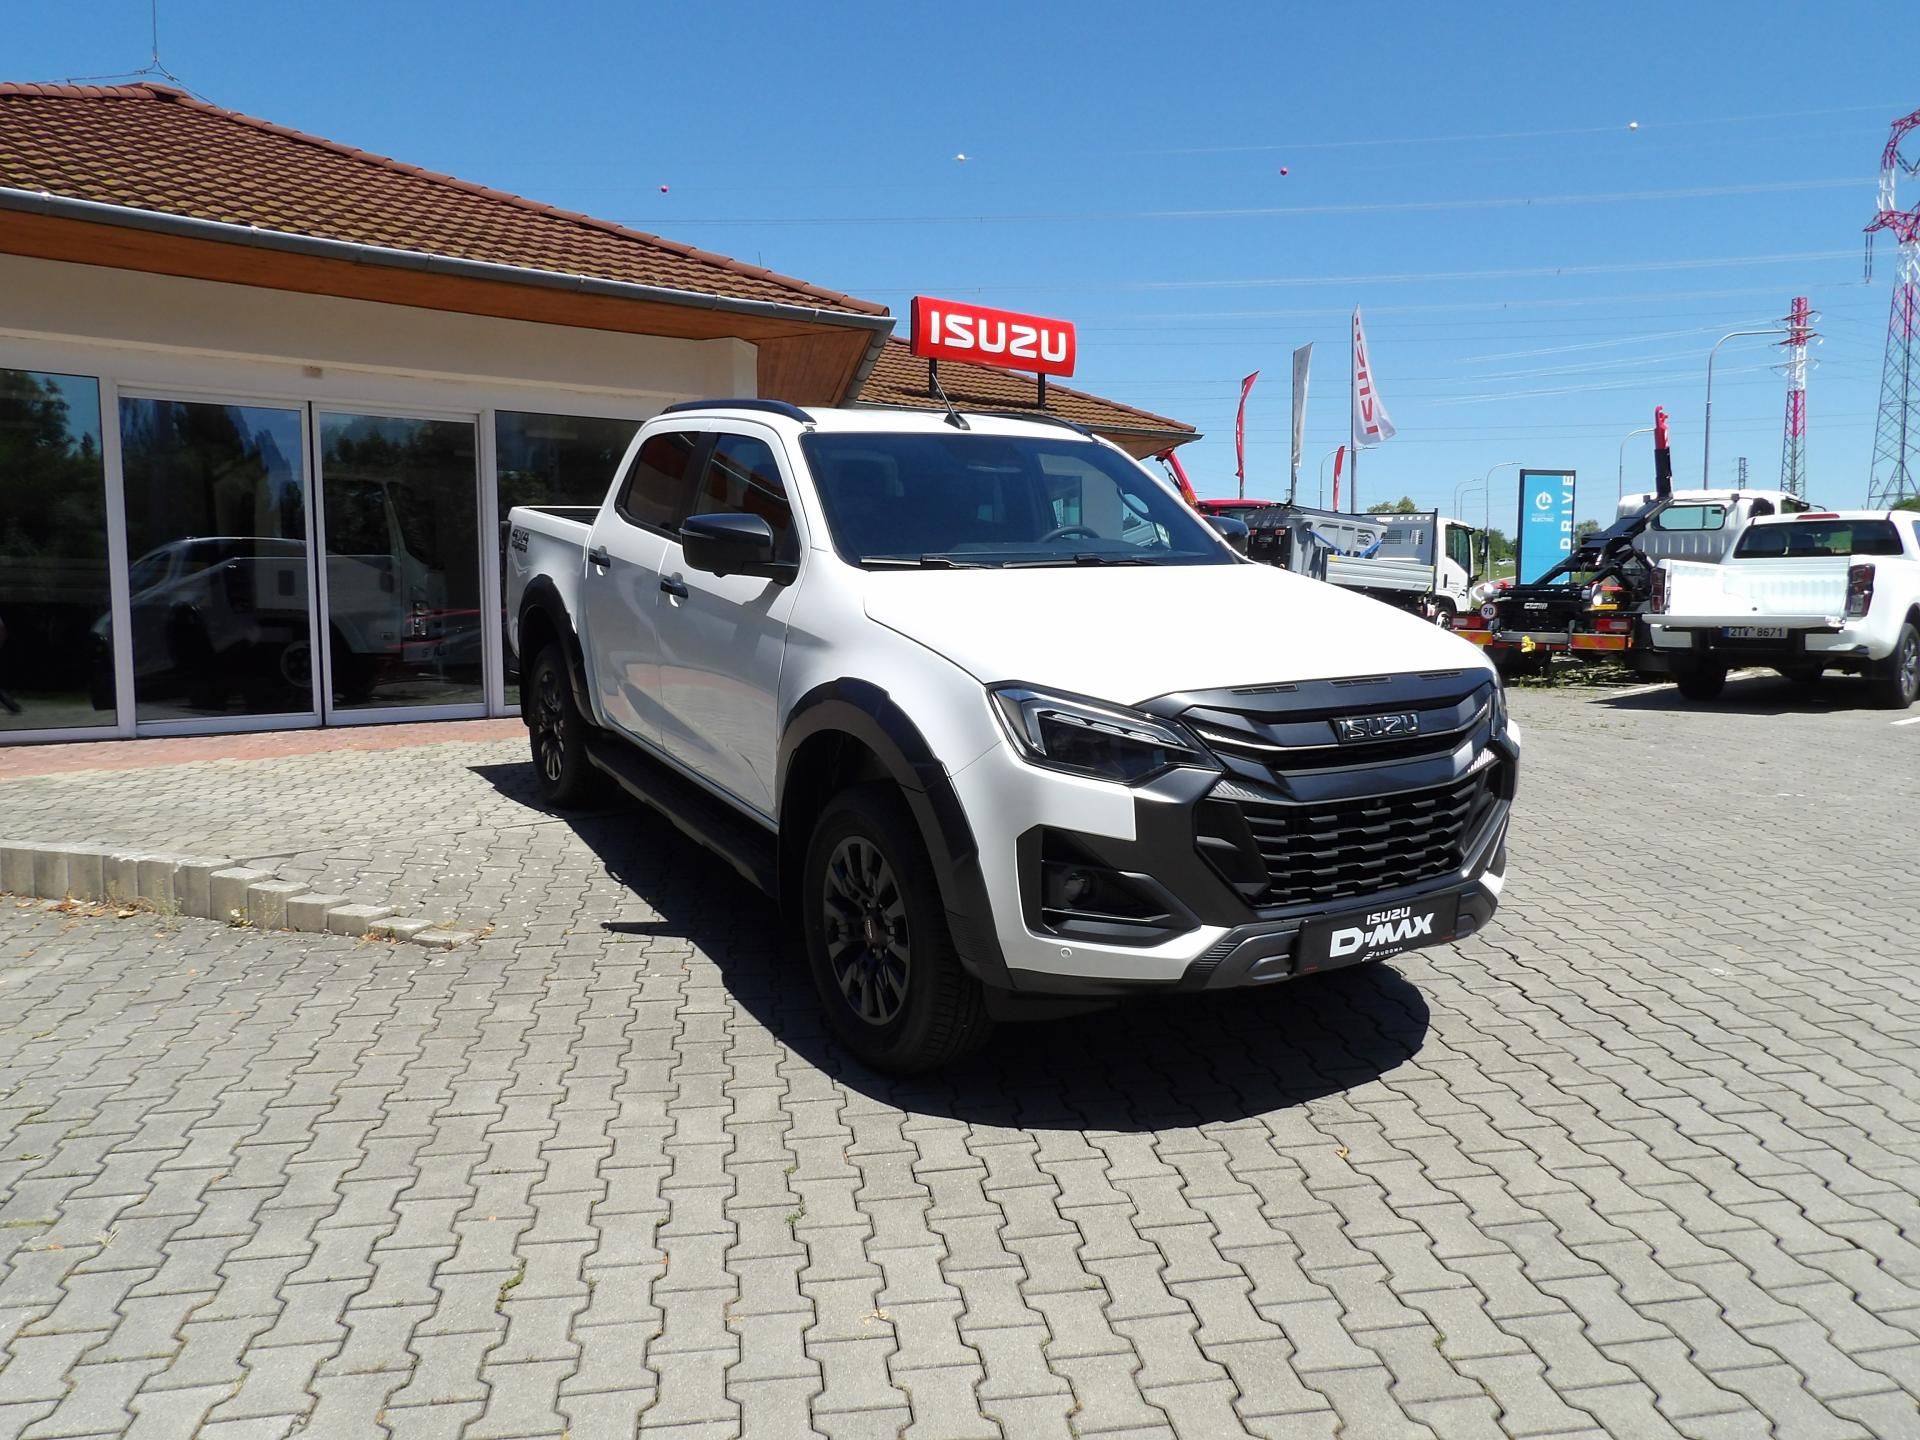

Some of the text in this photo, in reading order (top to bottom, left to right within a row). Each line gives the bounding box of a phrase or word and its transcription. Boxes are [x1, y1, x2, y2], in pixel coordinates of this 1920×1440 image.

[930, 311, 1067, 363] ISUZU
[1560, 475, 1575, 550] DRIVE
[1483, 607, 1494, 616] 90
[1339, 713, 1418, 741] ISUZU
[1366, 906, 1411, 925] ISUZU
[1329, 912, 1435, 958] D-MAX
